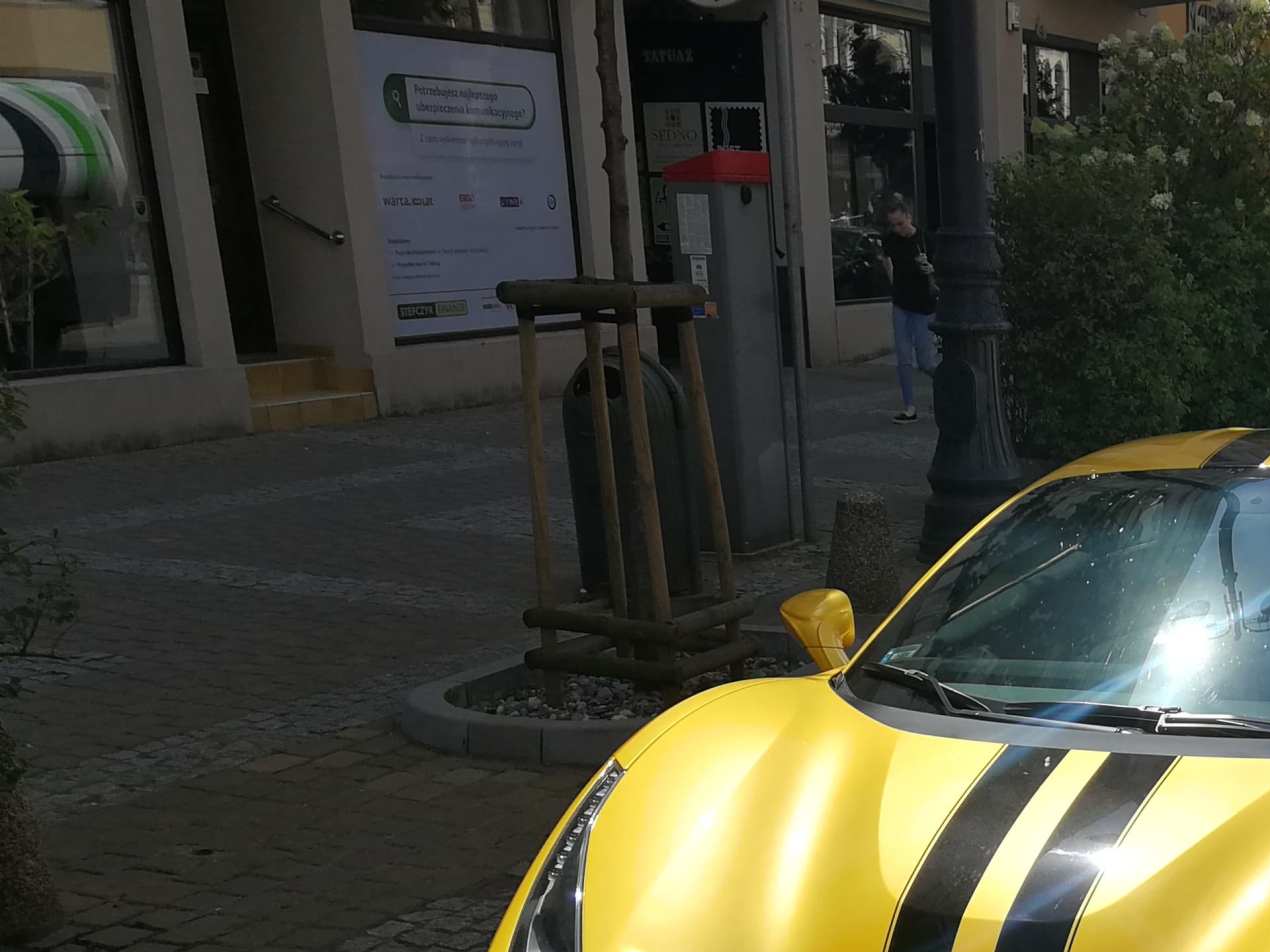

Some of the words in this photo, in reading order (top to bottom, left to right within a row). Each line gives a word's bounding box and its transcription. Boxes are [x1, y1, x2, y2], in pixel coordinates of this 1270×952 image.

[414, 84, 458, 99] Potrzebujesz
[459, 89, 498, 103] najlepszego
[416, 102, 465, 115] ubezpieczenia
[651, 129, 698, 141] SEDNO
[400, 305, 434, 317] STEFCZYK
